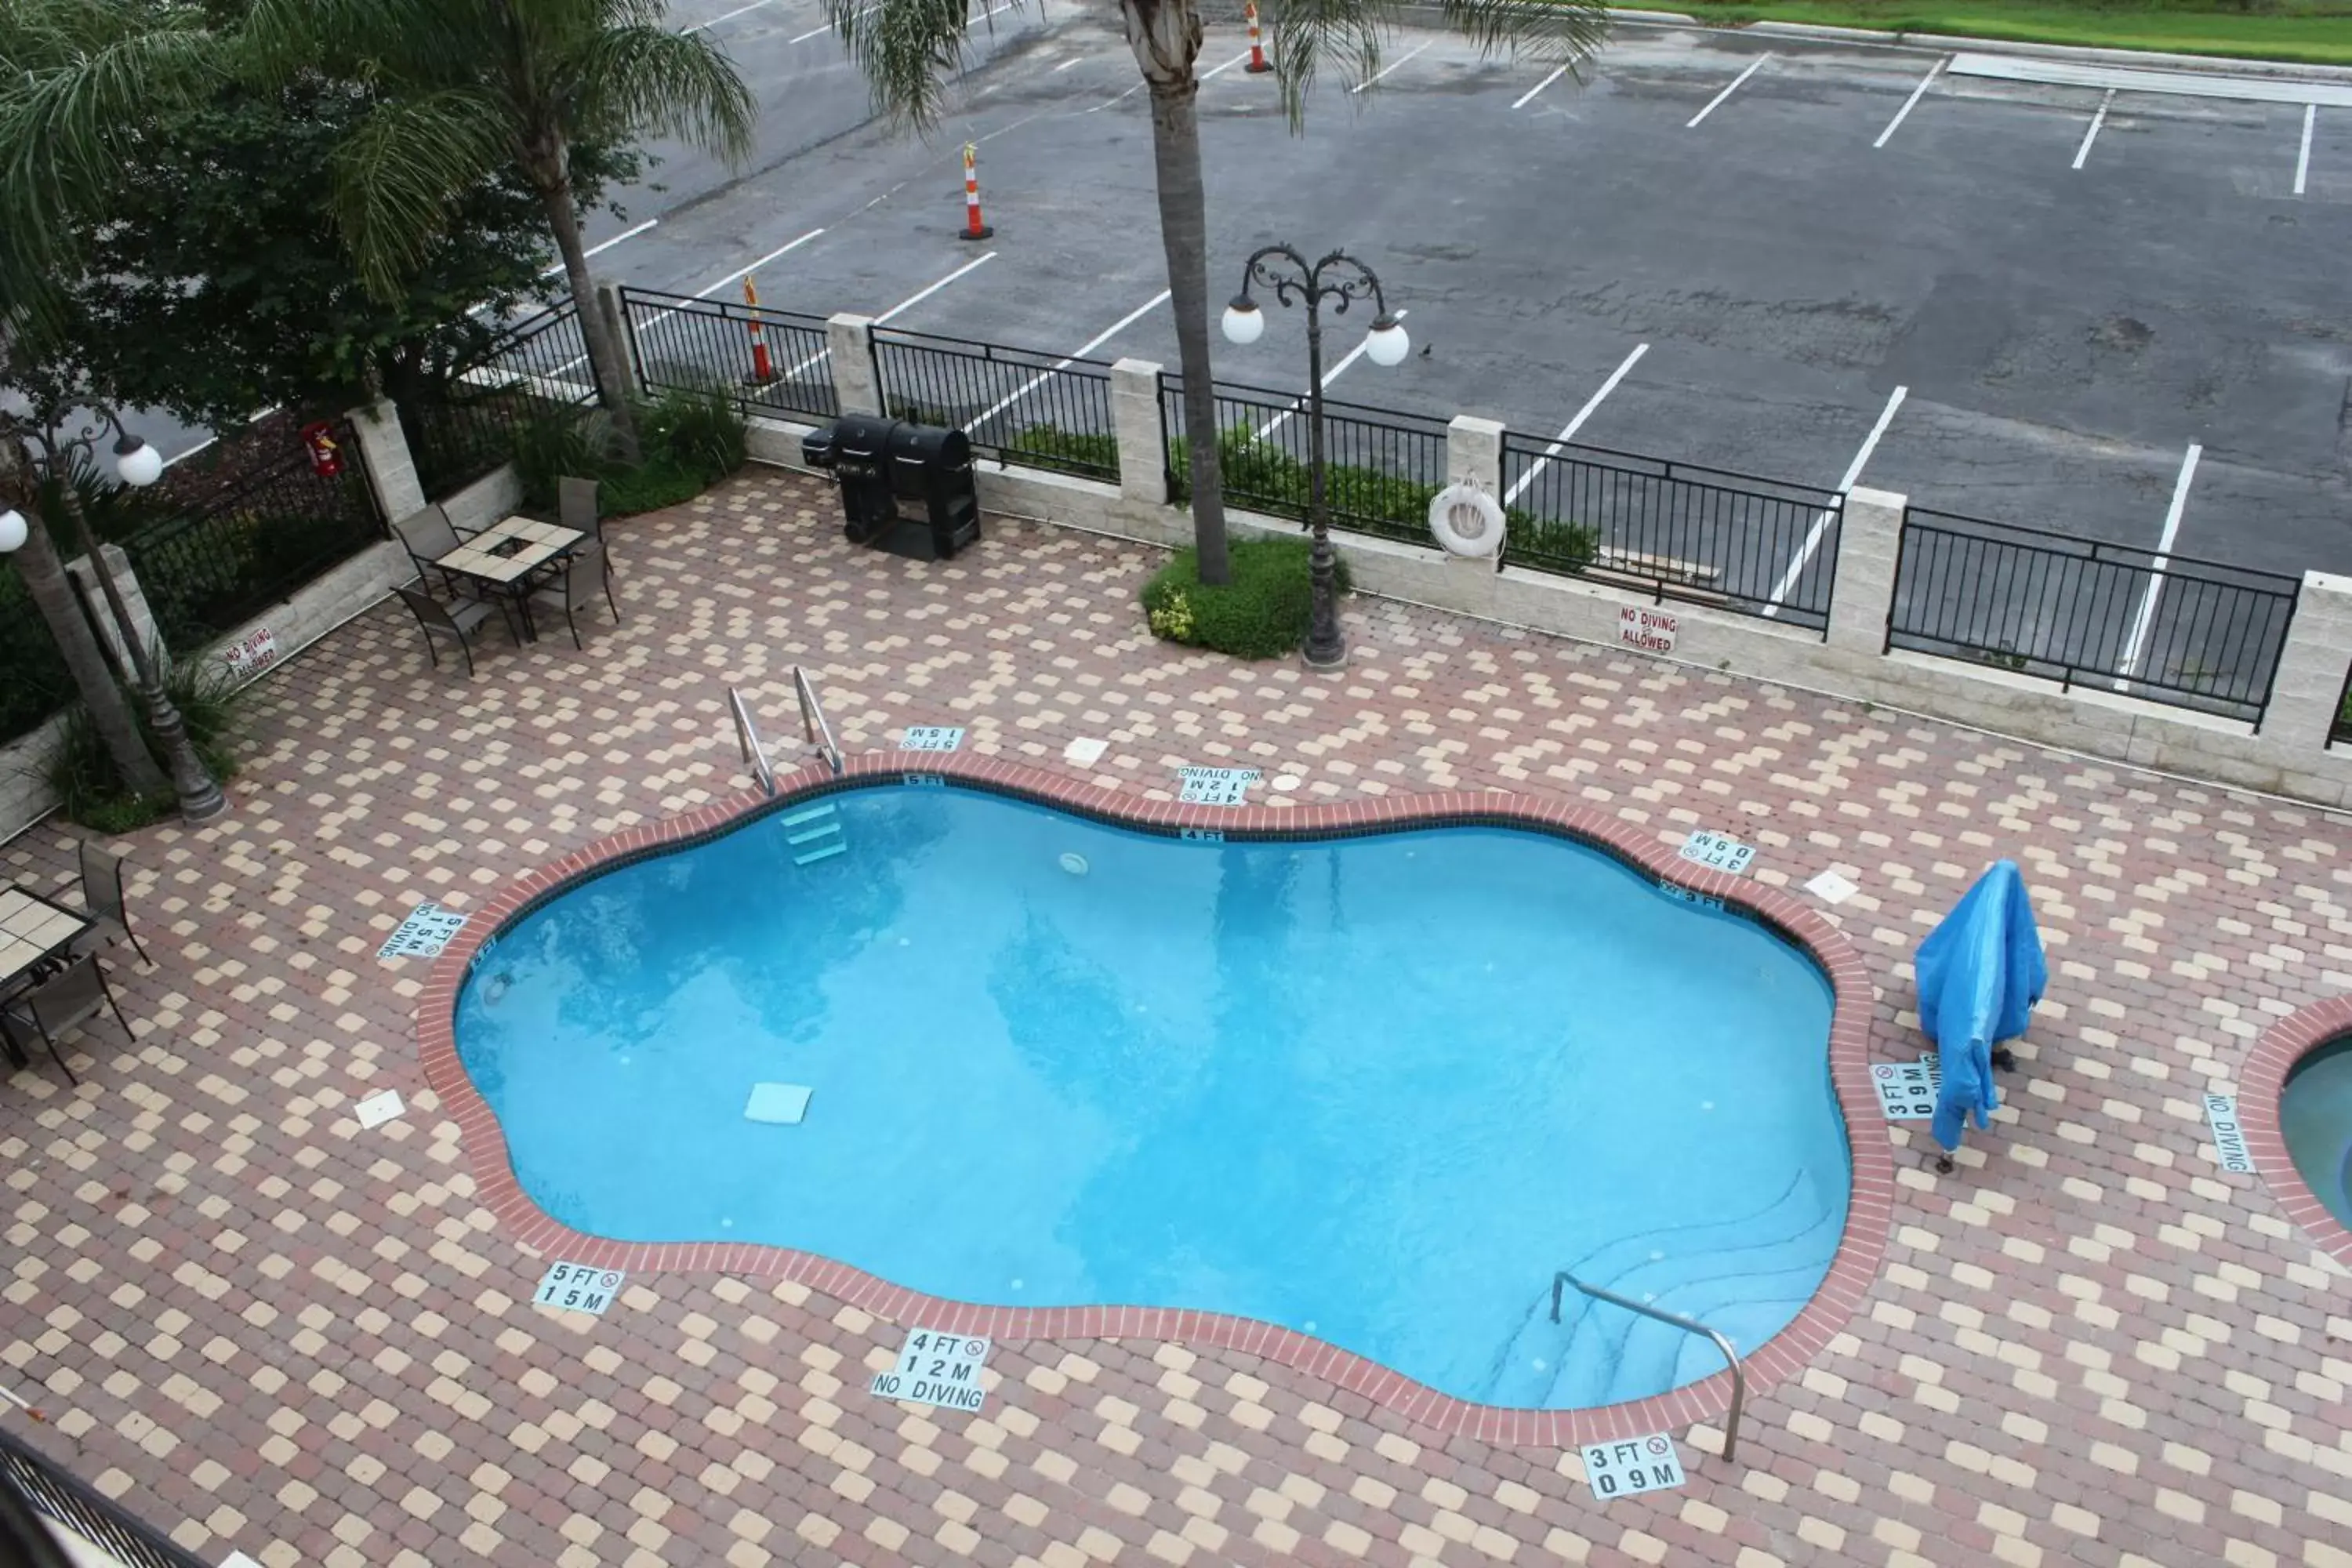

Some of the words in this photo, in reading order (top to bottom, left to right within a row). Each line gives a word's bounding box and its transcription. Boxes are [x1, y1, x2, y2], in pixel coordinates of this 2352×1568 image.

[1621, 607, 1635, 621] NO
[1640, 613, 1676, 633] DIVING
[226, 647, 240, 660] NO
[243, 628, 270, 652] DIVING
[1622, 630, 1671, 651] ALLOWED
[911, 728, 925, 737] M
[920, 740, 938, 749] FT
[944, 740, 953, 750] 5
[1179, 768, 1230, 779] DIVING
[1241, 771, 1264, 780] NO
[909, 775, 919, 785] 5
[925, 775, 941, 785] FT
[1190, 780, 1204, 789] M
[1210, 781, 1221, 790] 2
[1200, 793, 1221, 802] FT
[1226, 794, 1237, 803] 4
[1186, 830, 1196, 840] 4
[1203, 832, 1221, 840] FT
[1696, 833, 1711, 847] M
[1715, 841, 1730, 851] 9
[1702, 851, 1724, 865] FT
[1727, 859, 1741, 870] 3
[1686, 892, 1696, 902] 3
[1703, 898, 1723, 908] FT
[416, 903, 437, 916] NO
[447, 917, 463, 926] 5
[418, 928, 434, 937] 5
[434, 928, 453, 942] FT
[379, 921, 419, 958] DIVING
[405, 939, 424, 950] M
[1902, 1069, 1924, 1080] M
[1881, 1083, 1904, 1099] FT
[1908, 1086, 1928, 1096] 9
[2208, 1095, 2230, 1112] NO
[1888, 1105, 1908, 1115] 3
[2215, 1122, 2248, 1171] DIVING
[553, 1265, 570, 1280] 5
[571, 1268, 599, 1286] FT
[544, 1286, 556, 1301] 1
[564, 1290, 580, 1305] 5
[583, 1293, 604, 1310] M
[913, 1334, 929, 1351] 4
[933, 1337, 960, 1355] FT
[906, 1356, 918, 1373] 1
[928, 1359, 947, 1377] 2
[950, 1363, 972, 1381] M
[874, 1374, 901, 1393] NO
[912, 1381, 983, 1407] DIVING
[1590, 1448, 1608, 1468] 3
[1613, 1442, 1640, 1465] FT
[1598, 1473, 1617, 1494] 0
[1628, 1468, 1647, 1489] 9
[1651, 1464, 1675, 1485] M
